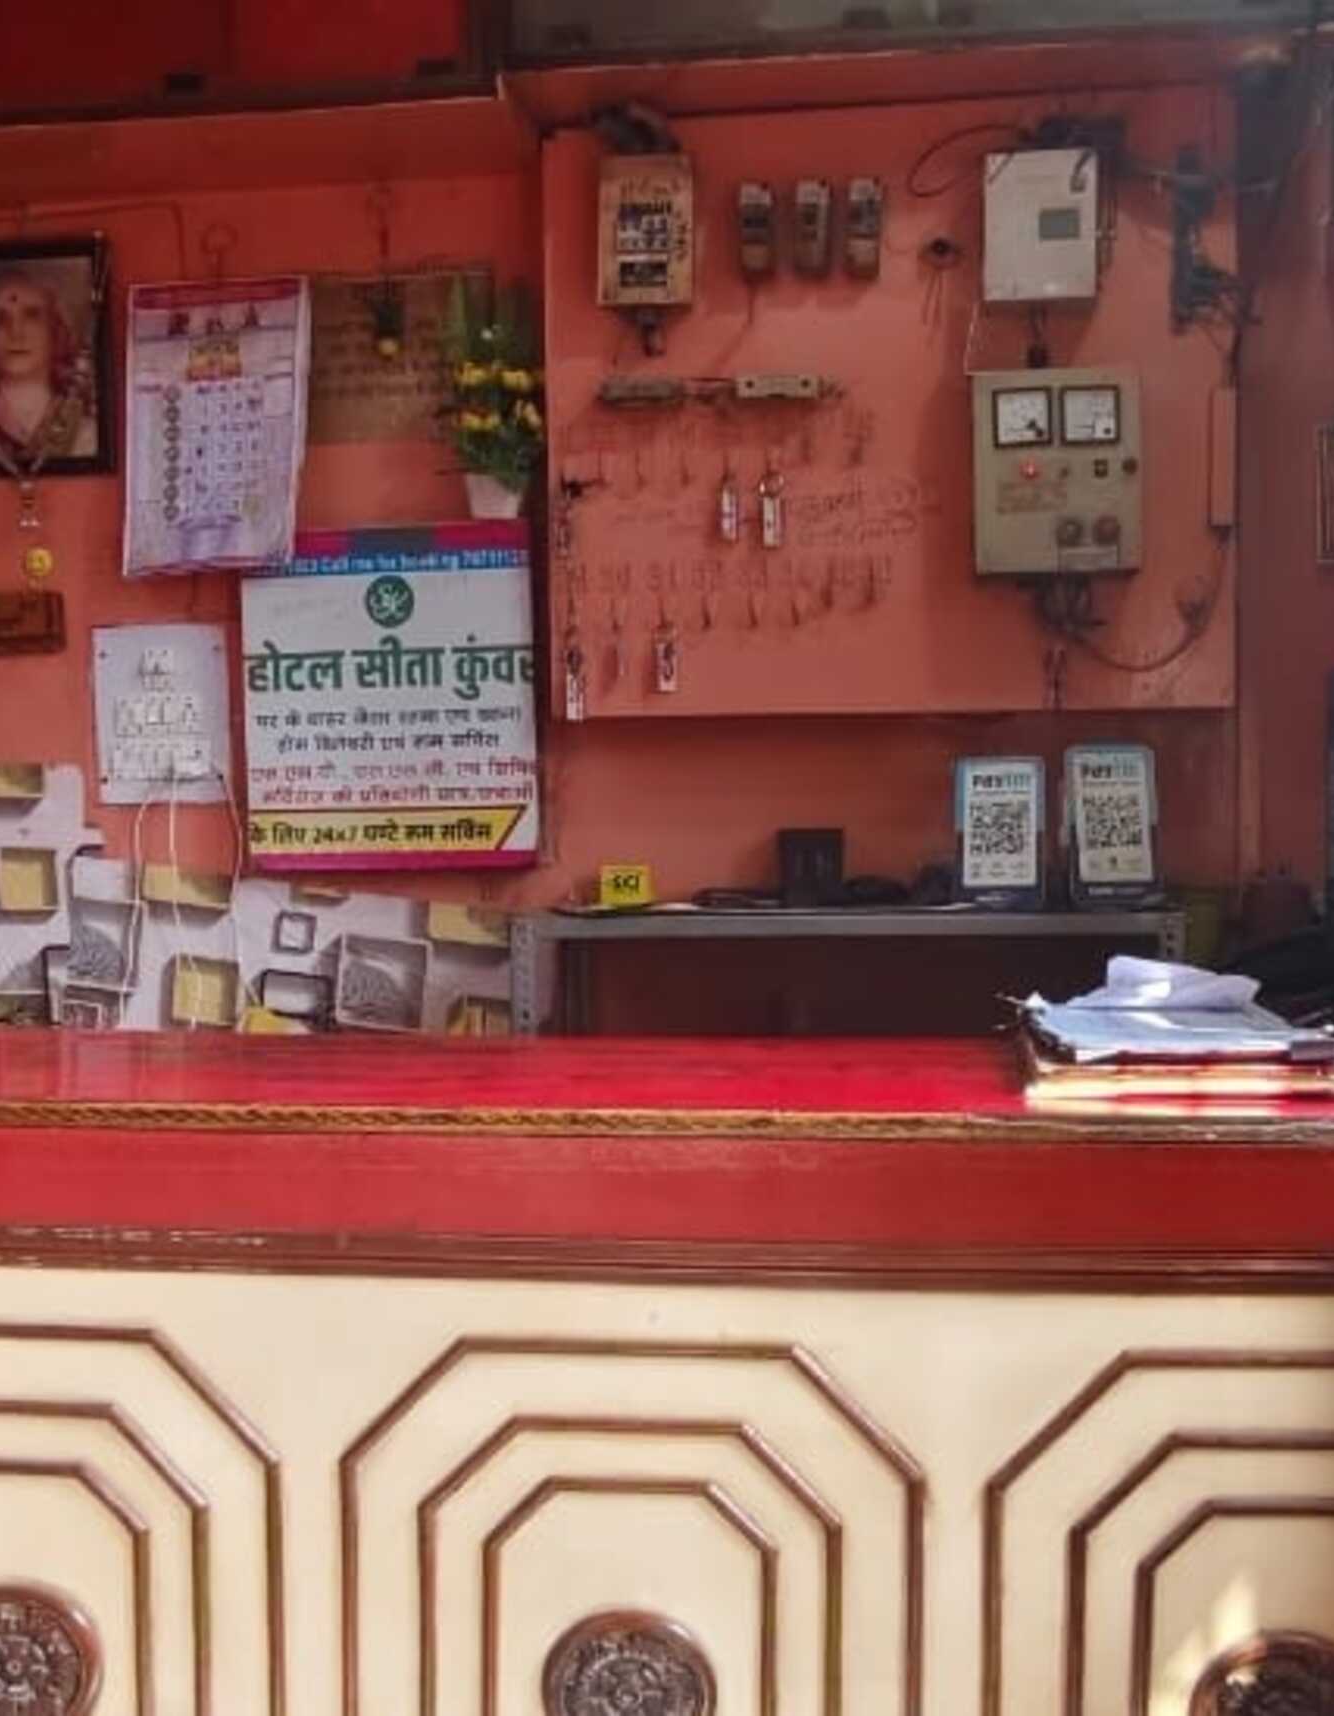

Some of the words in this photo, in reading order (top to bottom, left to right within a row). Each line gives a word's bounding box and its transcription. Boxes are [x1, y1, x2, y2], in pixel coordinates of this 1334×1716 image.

[243, 640, 345, 692] होटल
[351, 636, 445, 688] सीता
[271, 820, 306, 845] लिए
